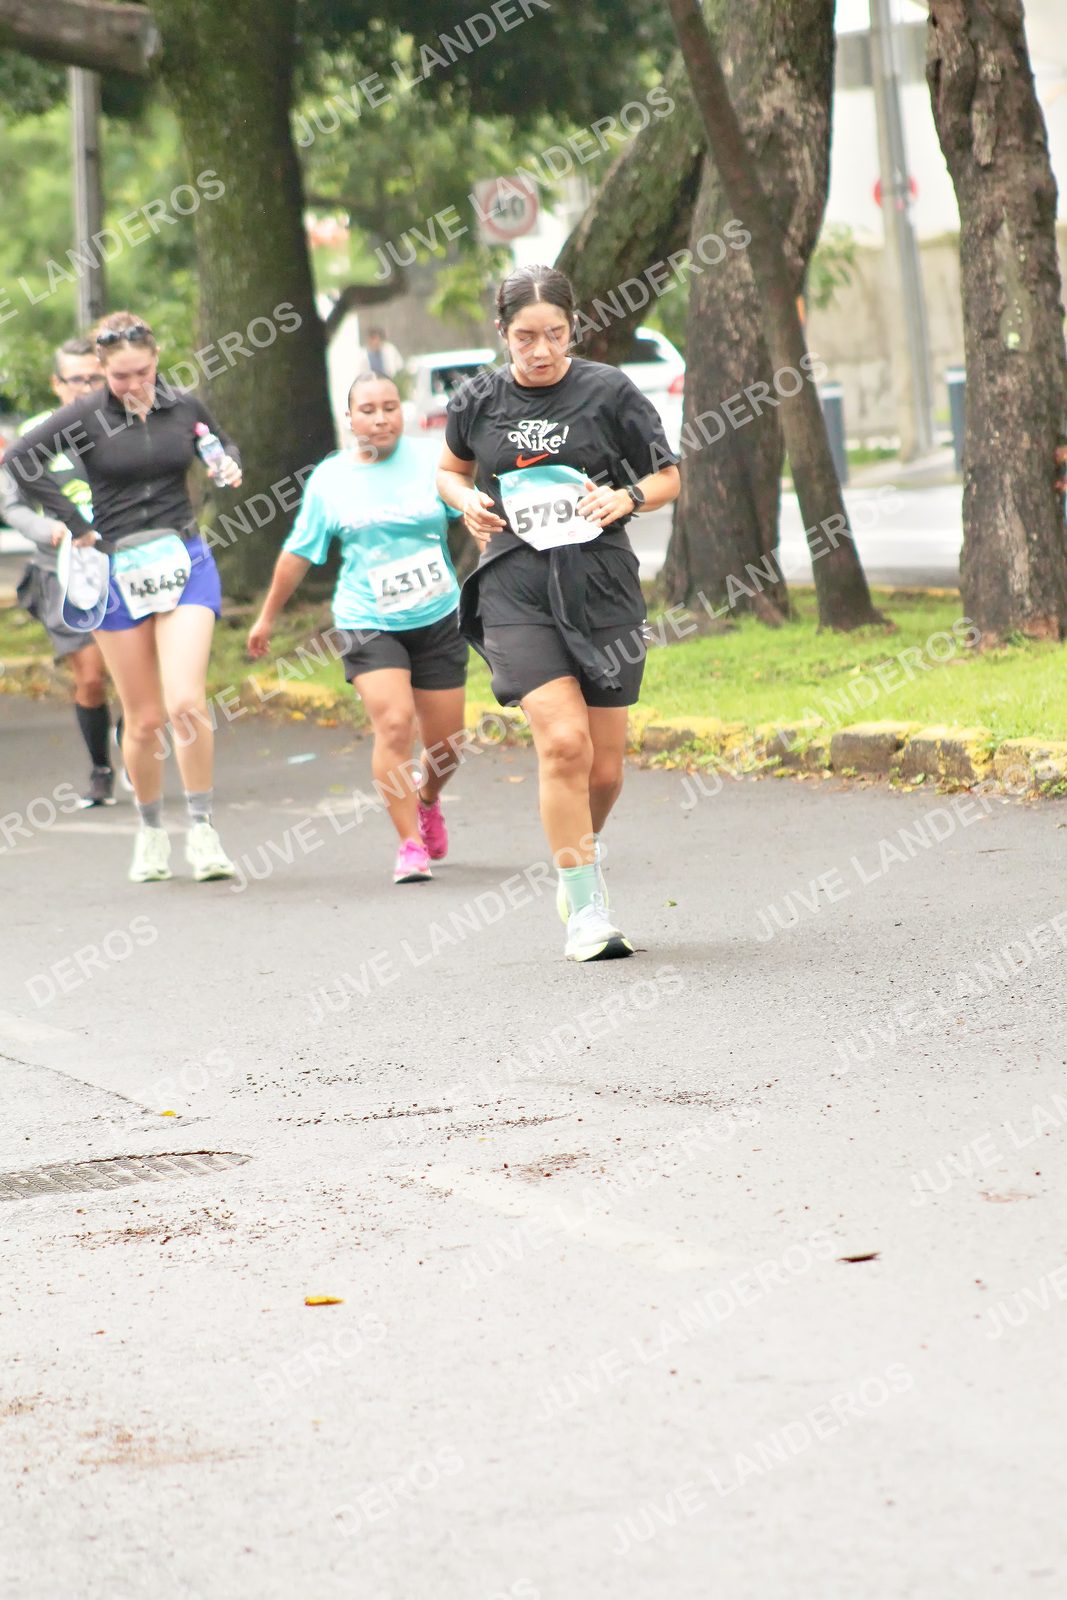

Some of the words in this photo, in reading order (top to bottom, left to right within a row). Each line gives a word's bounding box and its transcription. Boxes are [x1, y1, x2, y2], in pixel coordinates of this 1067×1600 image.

[508, 425, 569, 454] Nike!
[518, 419, 559, 435] Fly
[130, 568, 187, 598] 4848
[382, 561, 443, 597] 4315
